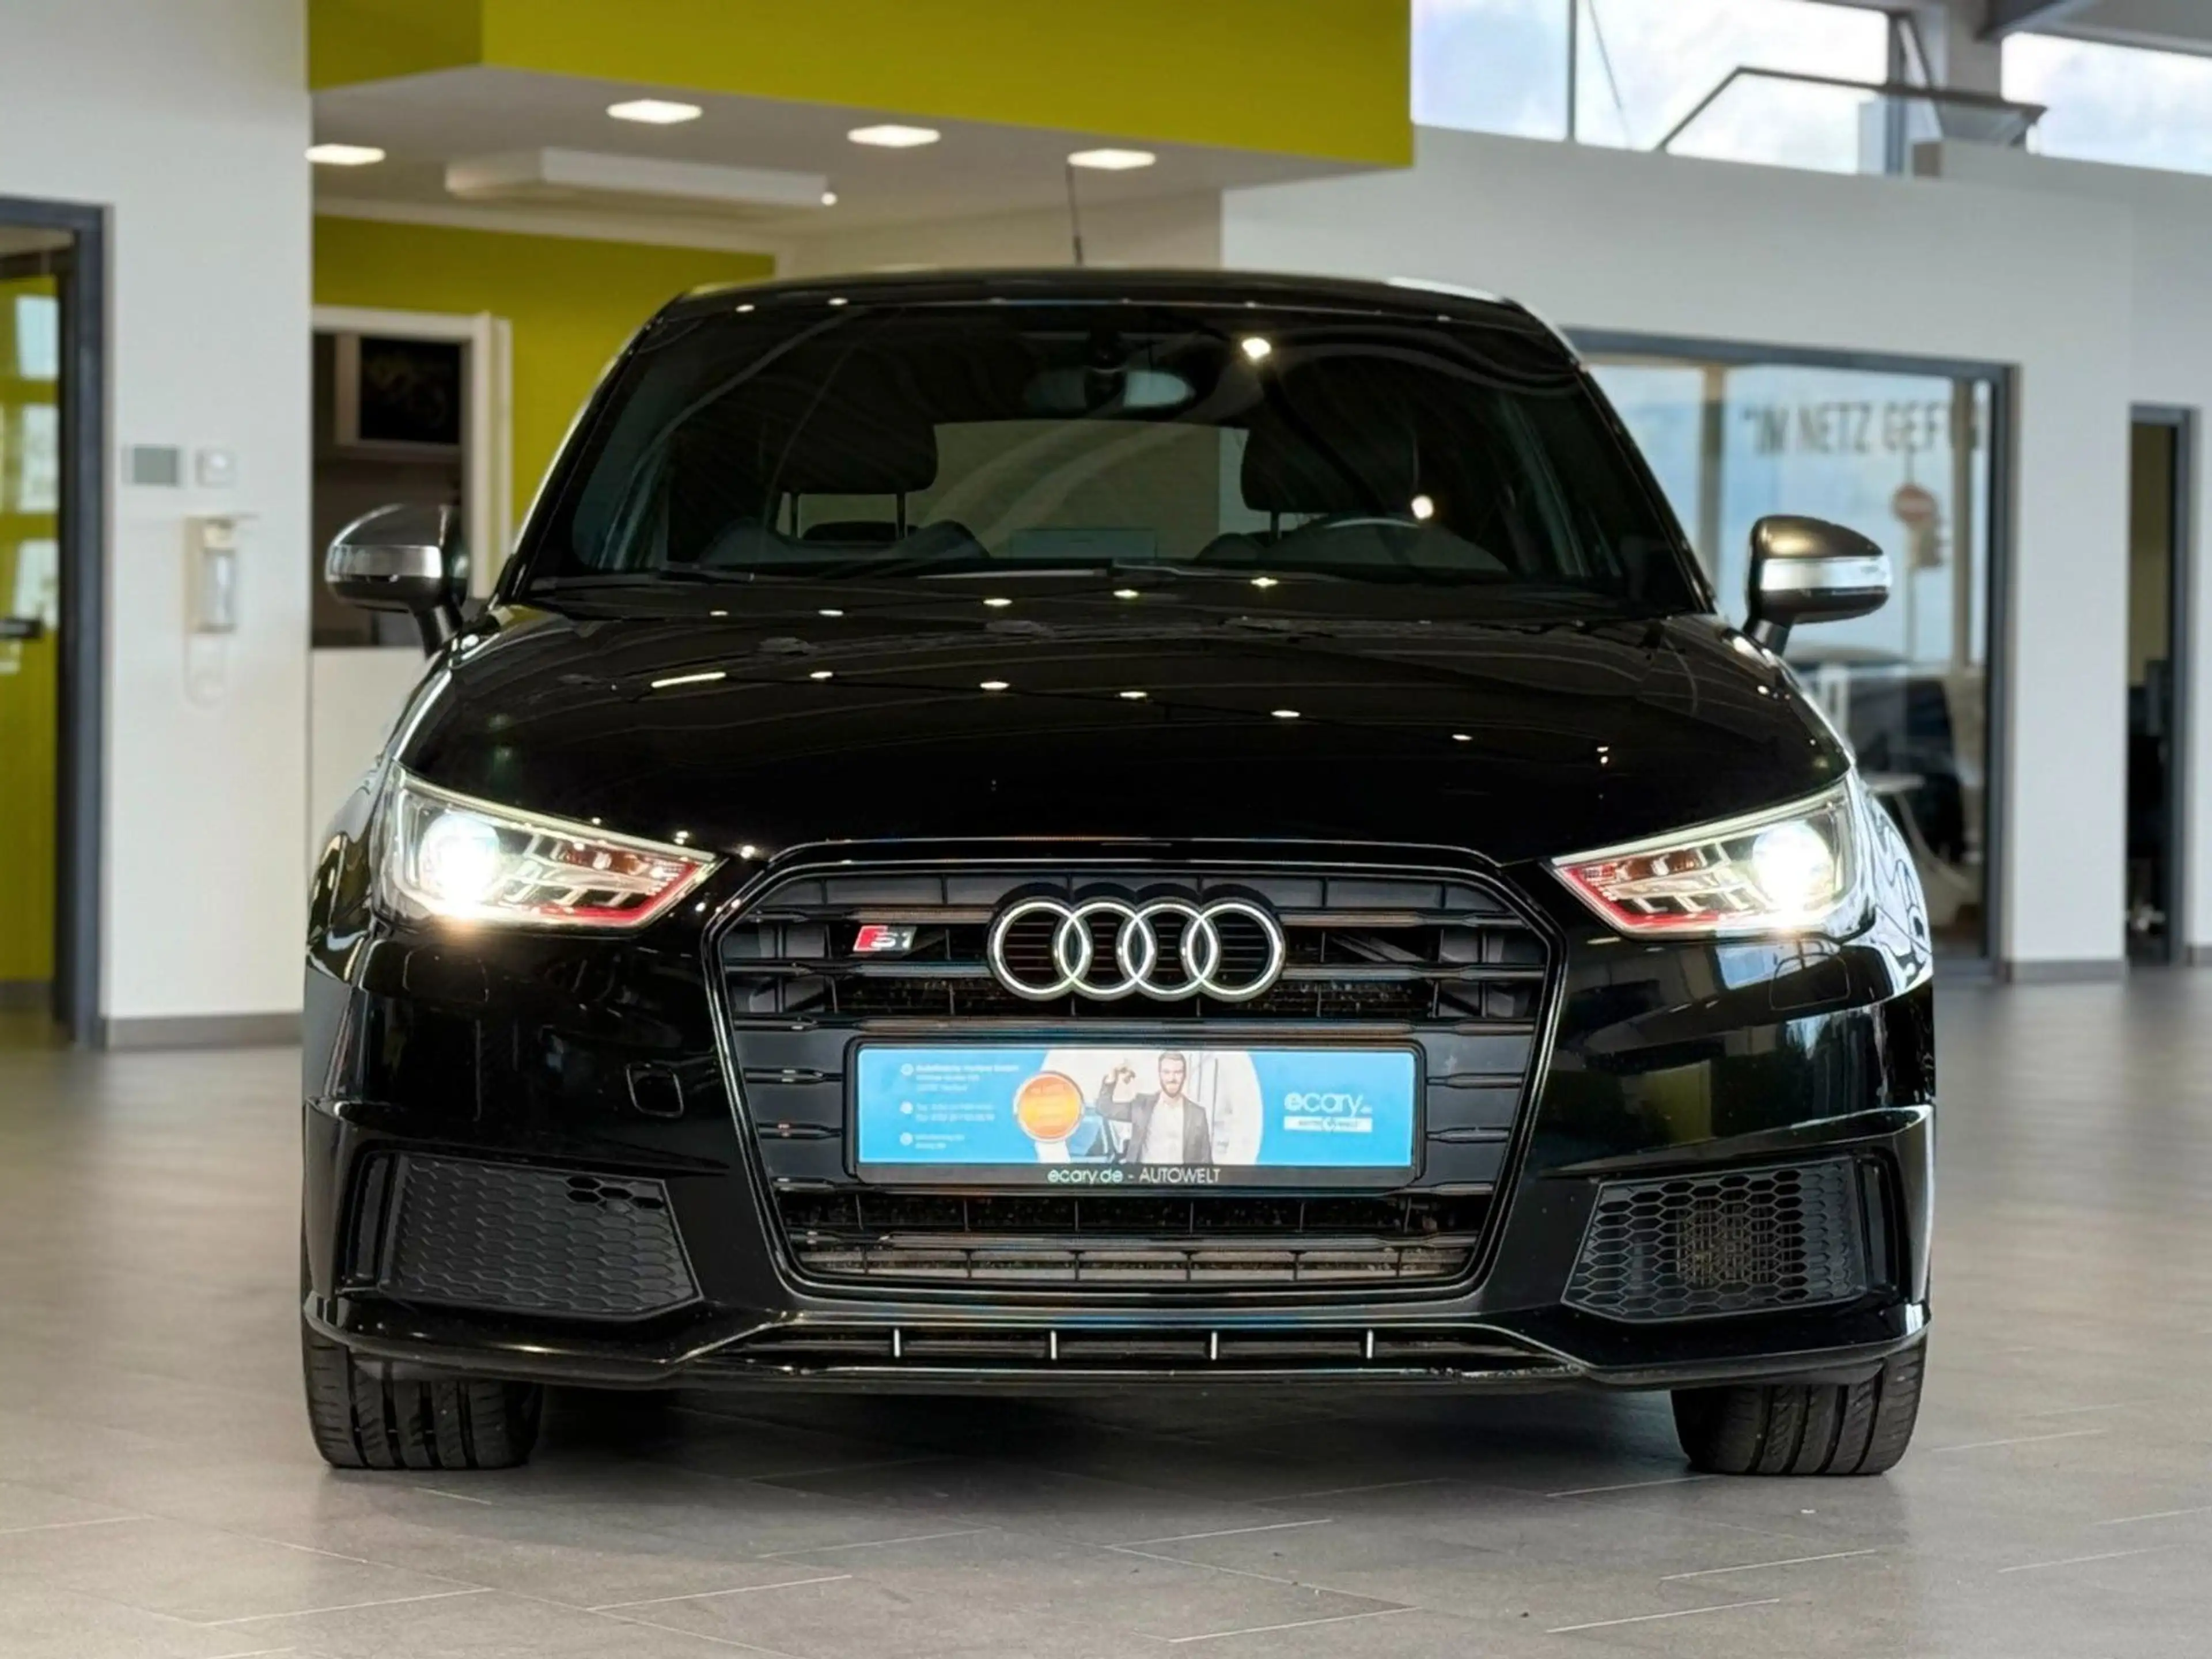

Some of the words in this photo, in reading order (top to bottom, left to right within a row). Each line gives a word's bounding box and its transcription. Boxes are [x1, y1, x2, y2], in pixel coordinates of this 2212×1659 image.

[1797, 402, 1872, 453] NETZ
[1047, 1169, 1123, 1184] ecary.de
[1138, 1167, 1221, 1184] AUTOWELT
